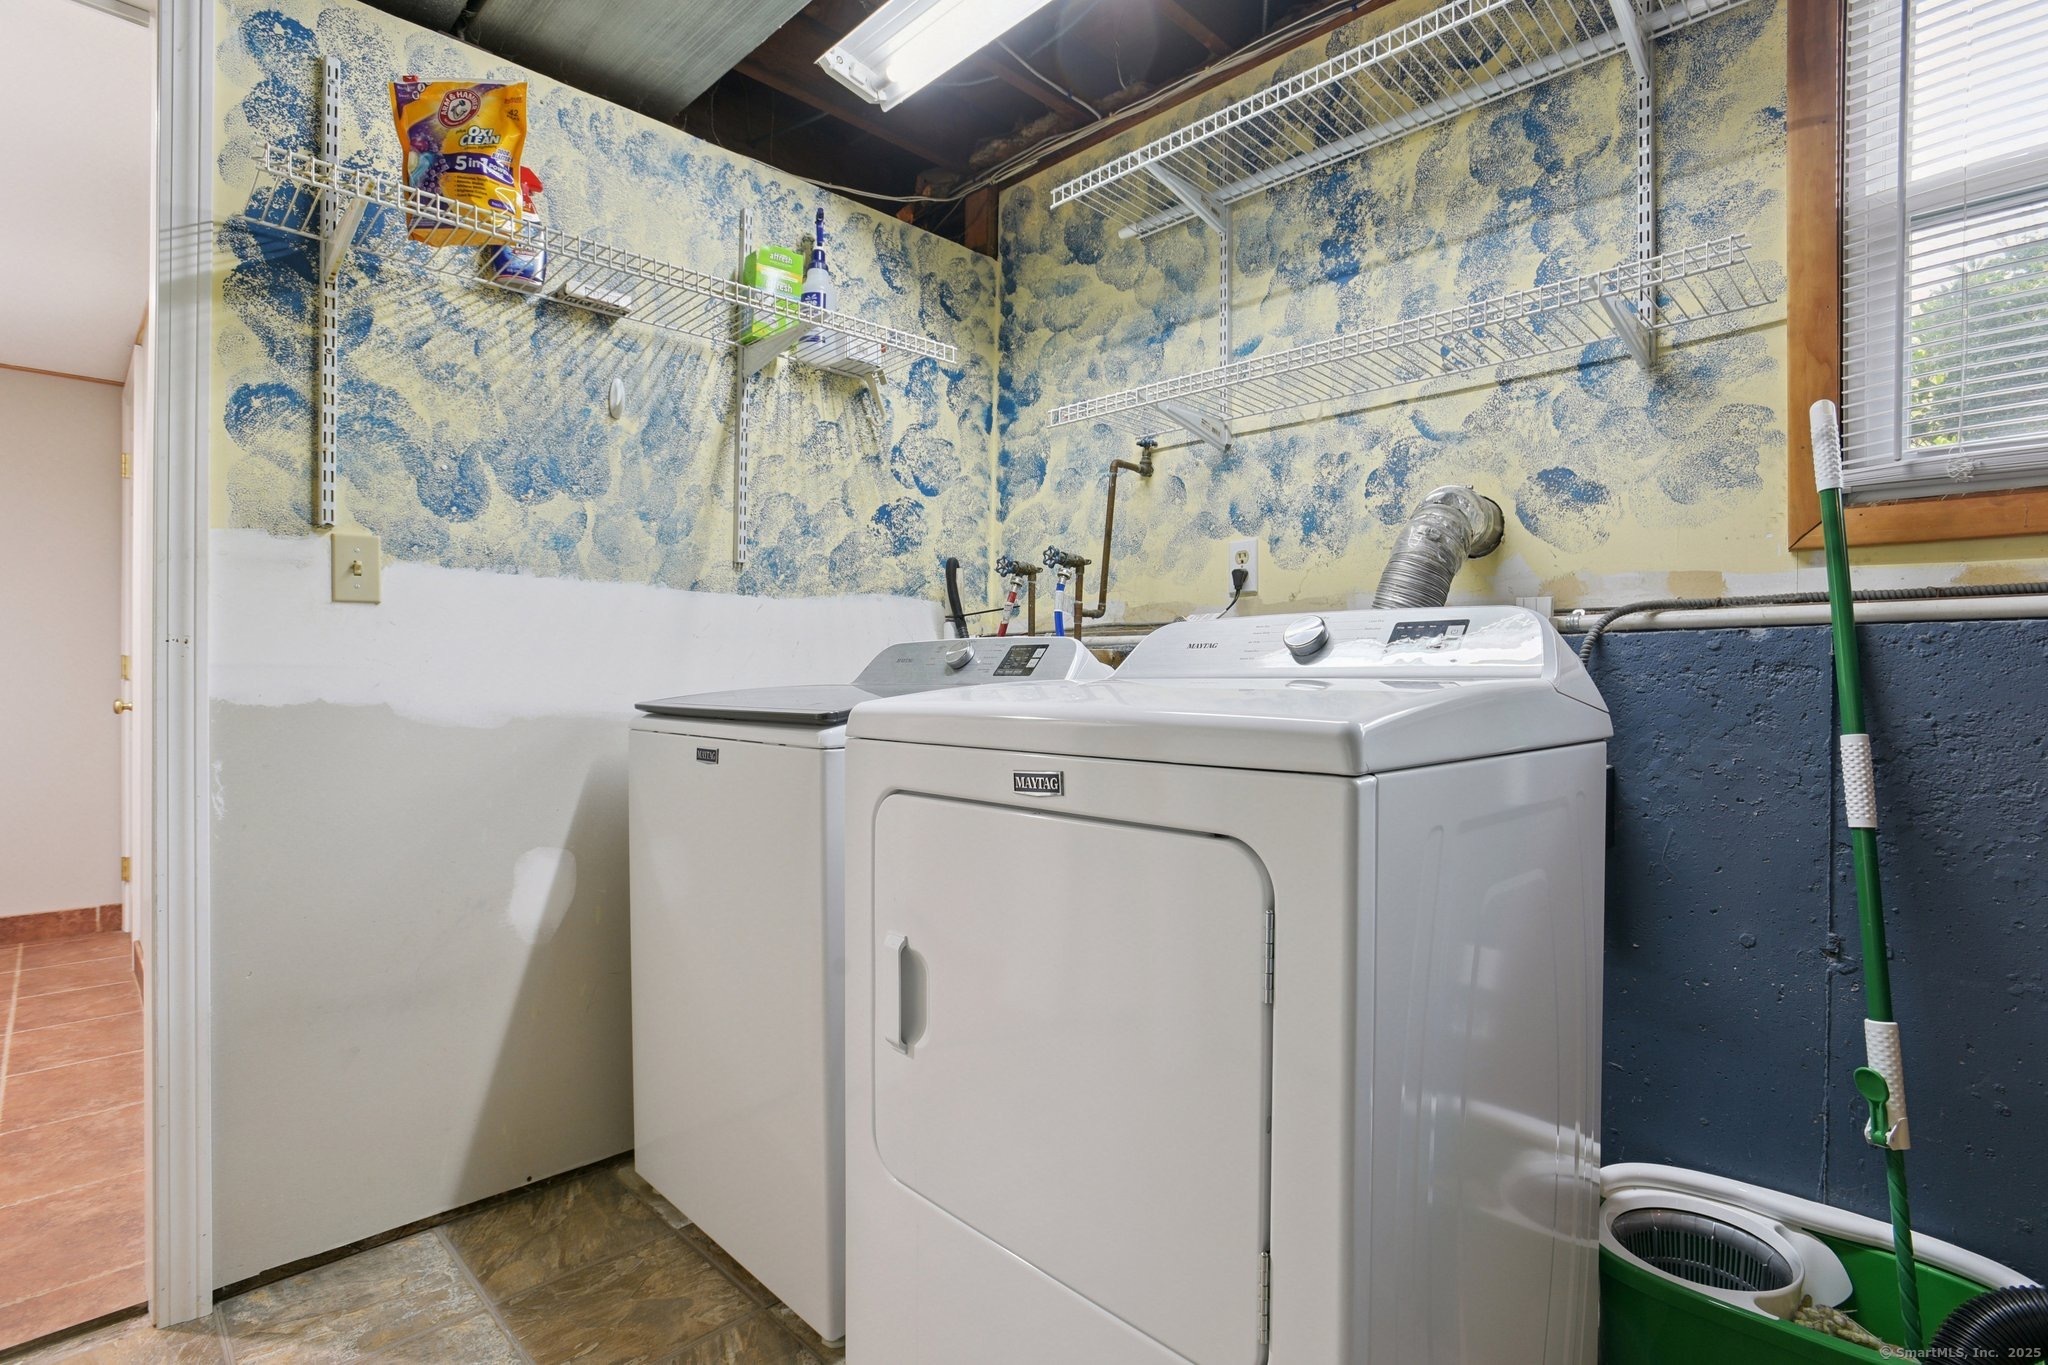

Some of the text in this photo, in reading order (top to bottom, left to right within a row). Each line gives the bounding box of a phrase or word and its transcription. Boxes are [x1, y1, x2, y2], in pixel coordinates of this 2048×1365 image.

[441, 98, 451, 115] ARM
[468, 125, 494, 137] OXI
[459, 134, 501, 147] CLEAN
[455, 155, 467, 171] 5
[468, 157, 480, 168] in
[480, 157, 489, 174] 1
[1187, 642, 1219, 650] MAYTAG
[1015, 776, 1059, 791] MAYTAG
